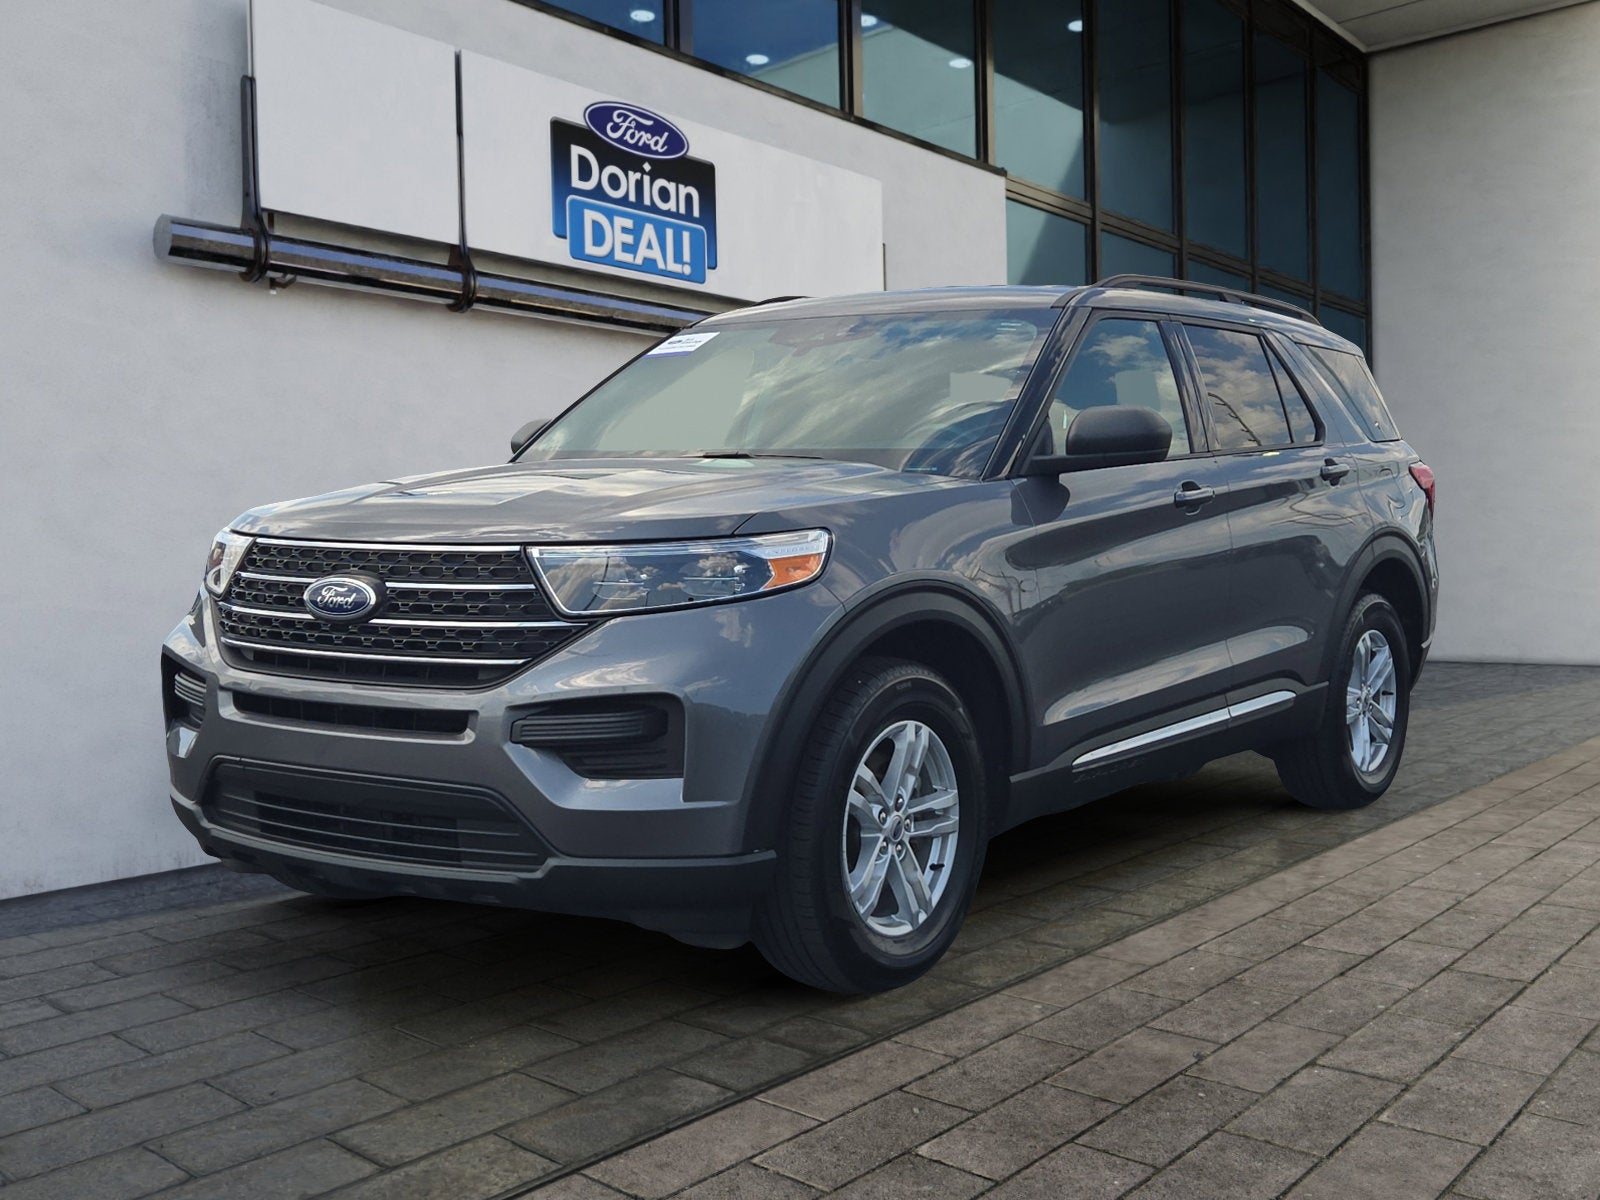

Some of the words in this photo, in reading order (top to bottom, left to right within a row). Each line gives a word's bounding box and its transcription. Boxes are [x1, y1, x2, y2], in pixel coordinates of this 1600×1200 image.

[606, 109, 669, 153] Ford
[570, 143, 700, 218] Dorian
[583, 208, 692, 276] DEAL!
[317, 585, 357, 609] Ford
